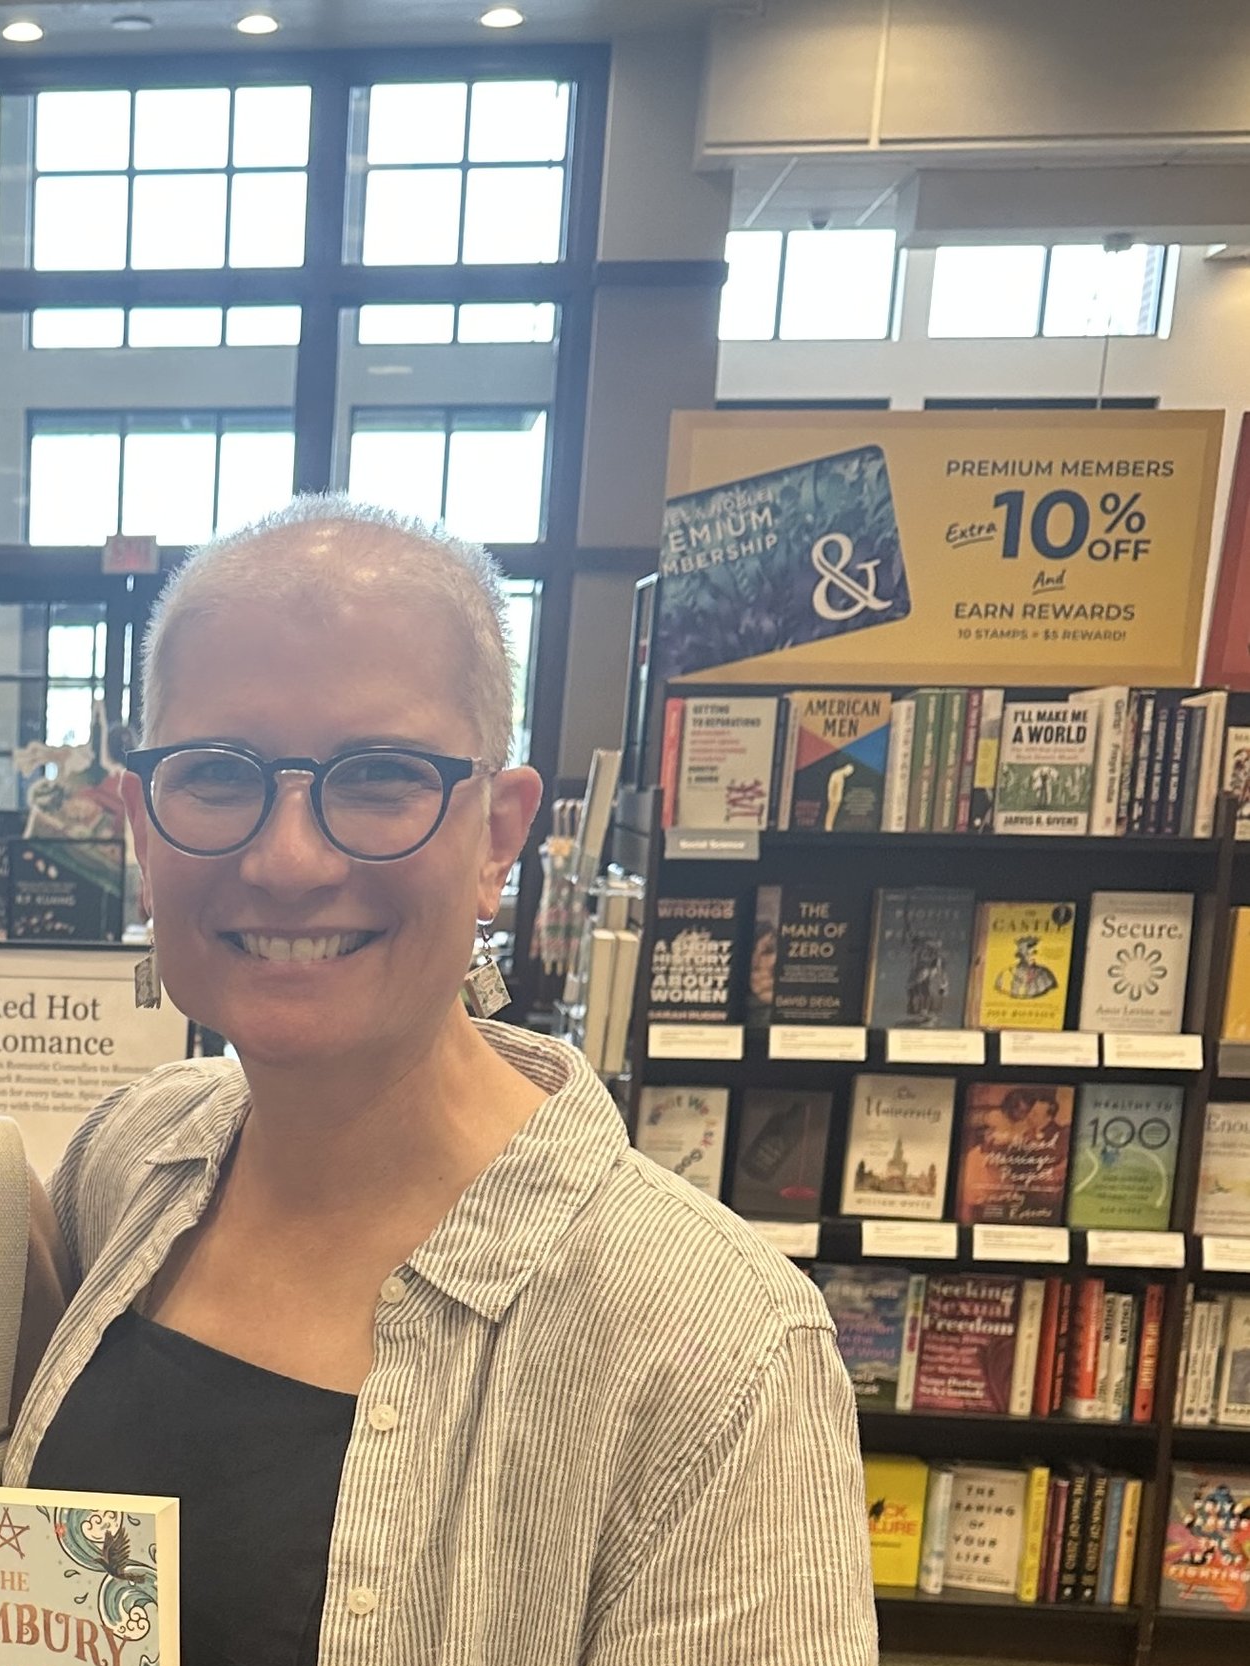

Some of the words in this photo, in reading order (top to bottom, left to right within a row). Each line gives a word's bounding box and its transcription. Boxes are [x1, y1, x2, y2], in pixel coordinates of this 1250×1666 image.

[946, 460, 1053, 478] PREMIUM
[1061, 460, 1174, 478] MEMBERS
[946, 521, 997, 543] Extra
[1088, 539, 1151, 562] OFF
[1032, 569, 1066, 590] And
[954, 602, 1014, 620] EARN
[1022, 603, 1135, 621] REWARDS
[958, 628, 971, 640] 10
[975, 629, 1028, 640] STAMPS
[1043, 629, 1058, 641] $5
[1062, 629, 1127, 642] REWARD!
[805, 699, 881, 718] AMERICAN
[1013, 709, 1034, 723] I'LL
[1037, 710, 1067, 723] MAKE
[1071, 710, 1088, 722] ME
[822, 719, 859, 738] MEN
[1012, 726, 1024, 744] A
[1028, 726, 1087, 744] WORLD
[799, 902, 830, 918] THE
[781, 923, 820, 938] MAN
[823, 922, 848, 938] OF
[1101, 914, 1184, 940] Secure.
[654, 939, 667, 953] A
[788, 941, 835, 958] ZERO
[652, 975, 729, 988] ABOUT
[651, 989, 728, 1003] WOMEN
[47, 994, 101, 1021] Hot
[1088, 1116, 1171, 1151] 100
[928, 1279, 1016, 1304] Seeking
[923, 1314, 1014, 1335] Freedom
[966, 1484, 995, 1498] THE
[953, 1533, 997, 1548] YOUR
[955, 1551, 991, 1565] LIFE
